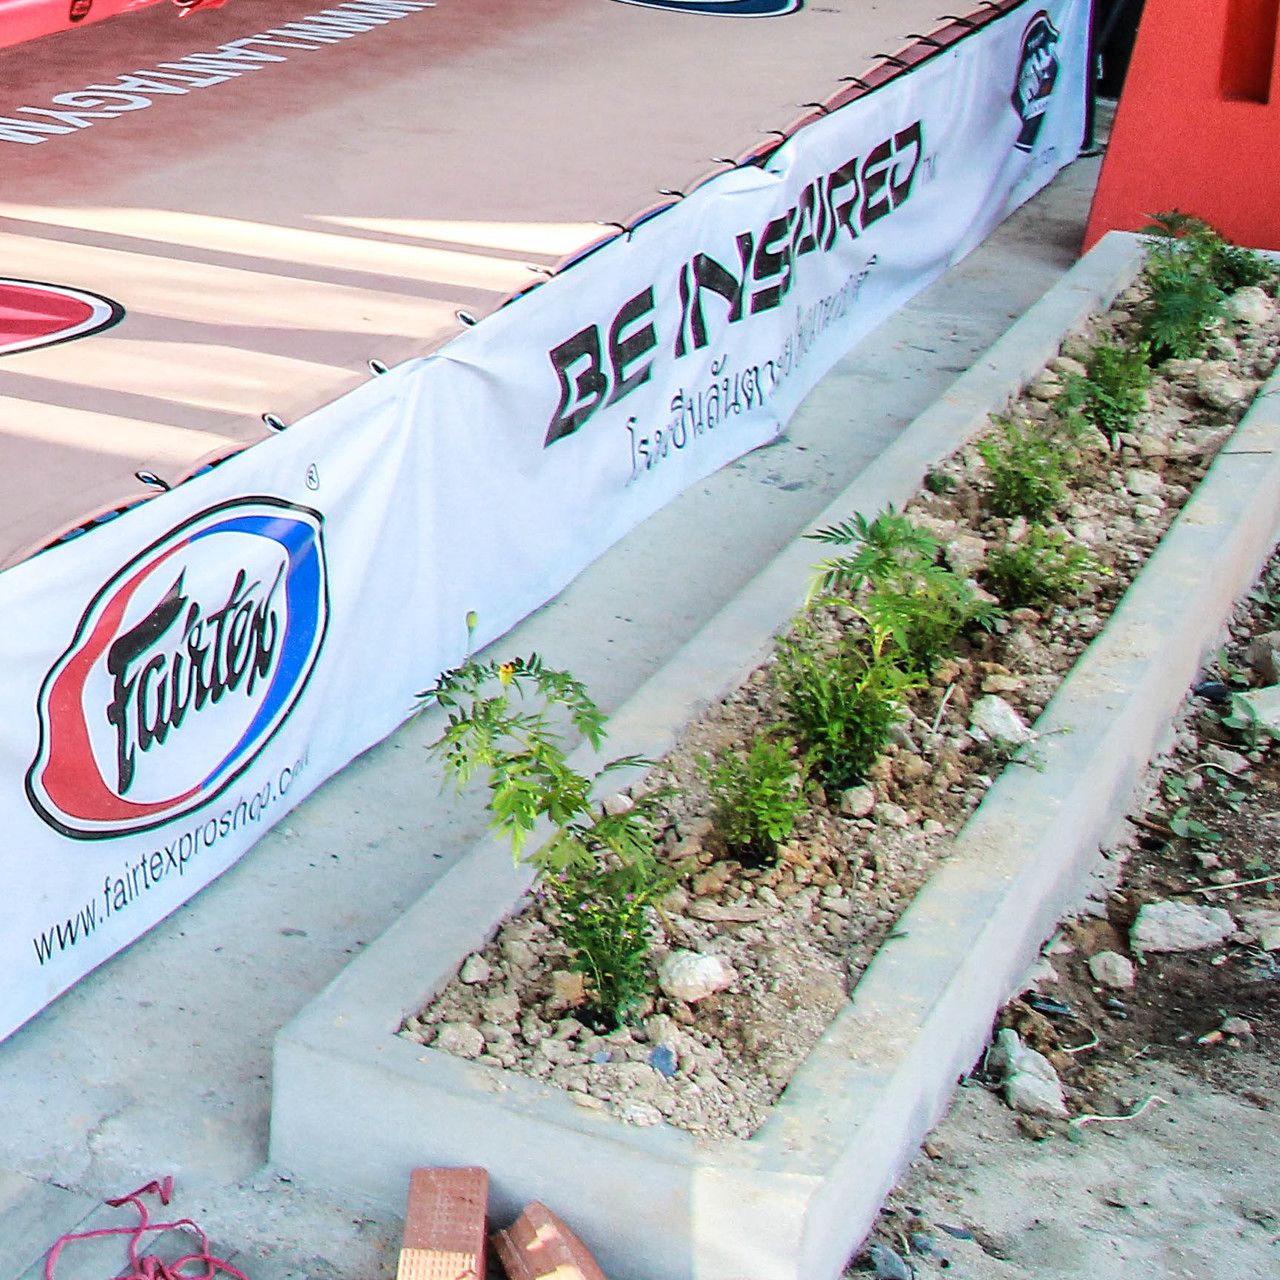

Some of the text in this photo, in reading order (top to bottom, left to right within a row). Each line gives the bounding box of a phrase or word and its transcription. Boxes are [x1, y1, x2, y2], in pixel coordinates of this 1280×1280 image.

[543, 284, 658, 450] BE
[674, 119, 923, 362] INSPIRED
[106, 558, 288, 797] Fairtex
